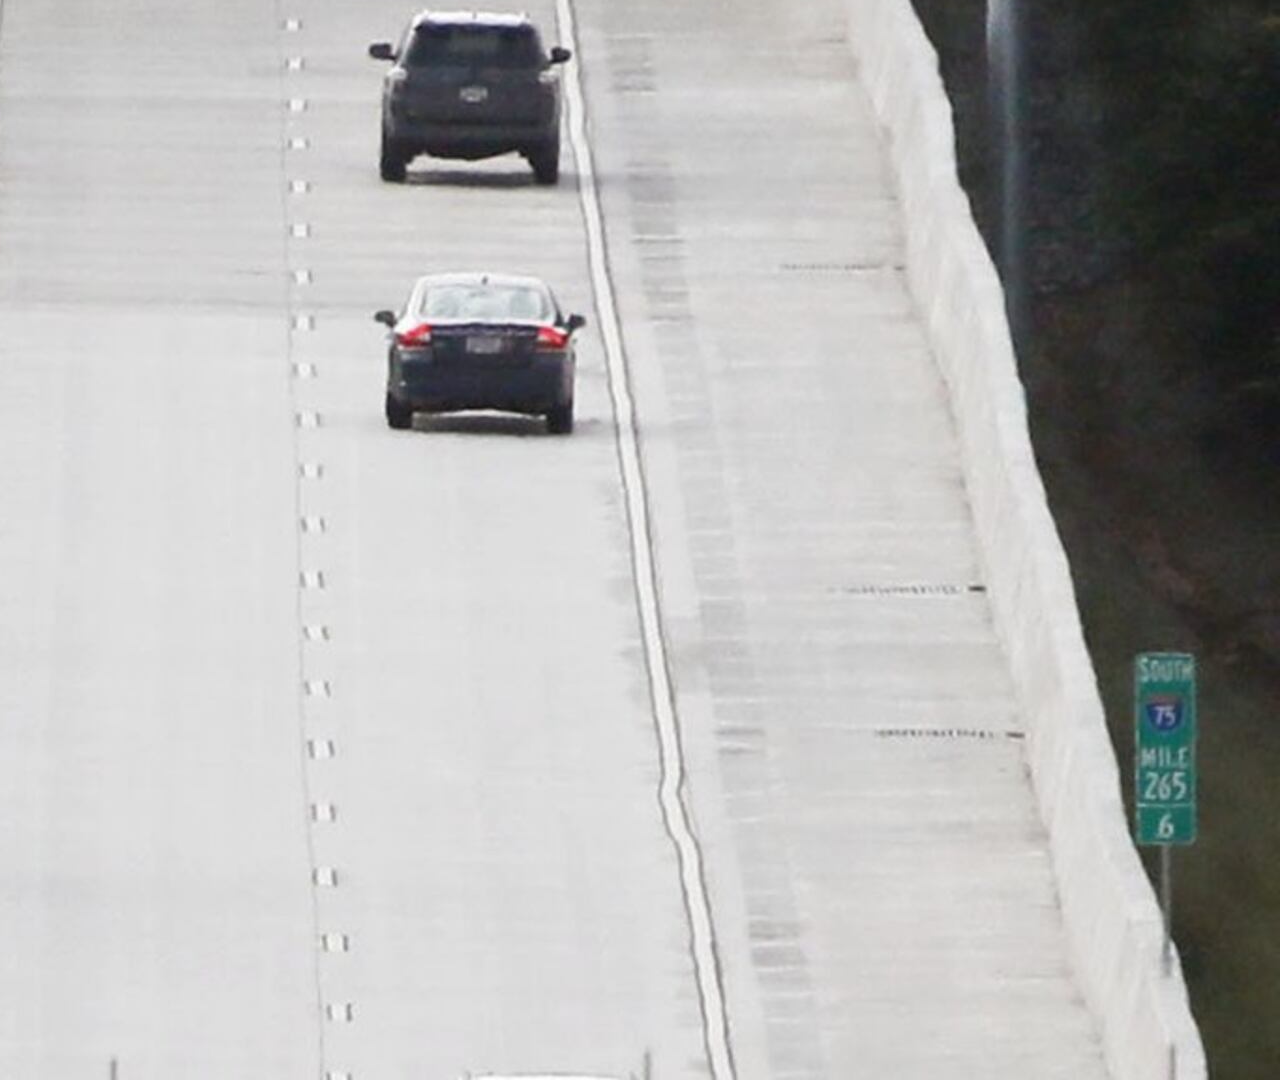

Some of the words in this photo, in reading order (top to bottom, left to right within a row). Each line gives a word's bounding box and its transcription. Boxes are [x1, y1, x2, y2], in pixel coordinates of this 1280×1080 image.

[1140, 657, 1193, 683] SOUTH
[1154, 705, 1176, 725] 75
[1140, 747, 1188, 769] MILE
[1144, 771, 1187, 801] 265
[1156, 813, 1174, 838] 6
